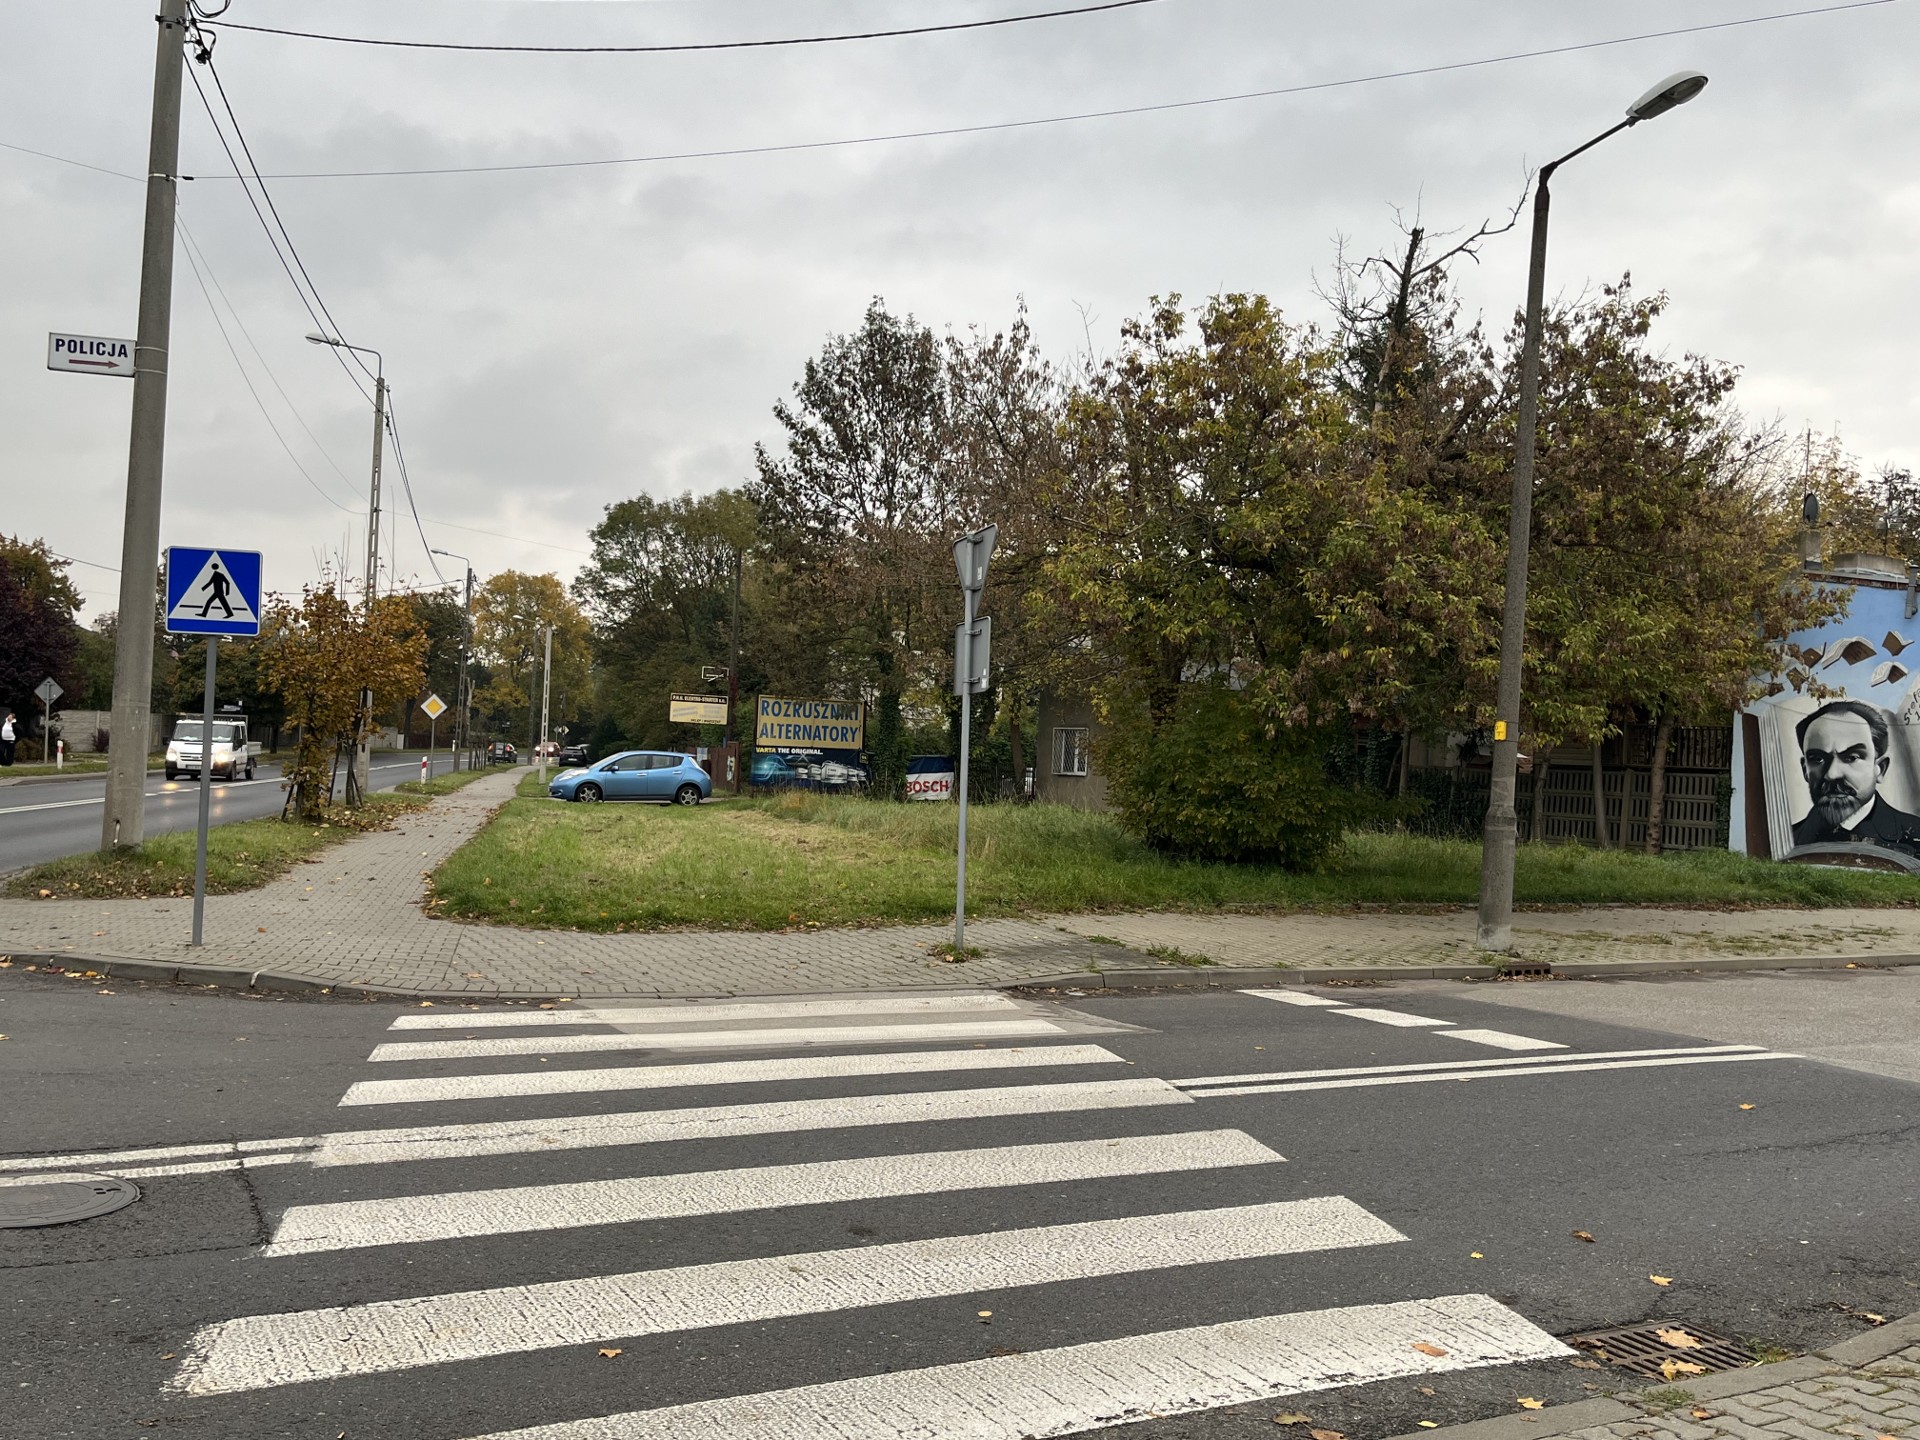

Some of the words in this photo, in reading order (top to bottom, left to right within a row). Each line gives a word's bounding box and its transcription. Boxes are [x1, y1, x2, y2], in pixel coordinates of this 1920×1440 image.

[55, 338, 129, 359] POLICJA
[760, 723, 858, 743] ALTERNATORY
[906, 780, 949, 793] BOSCH
